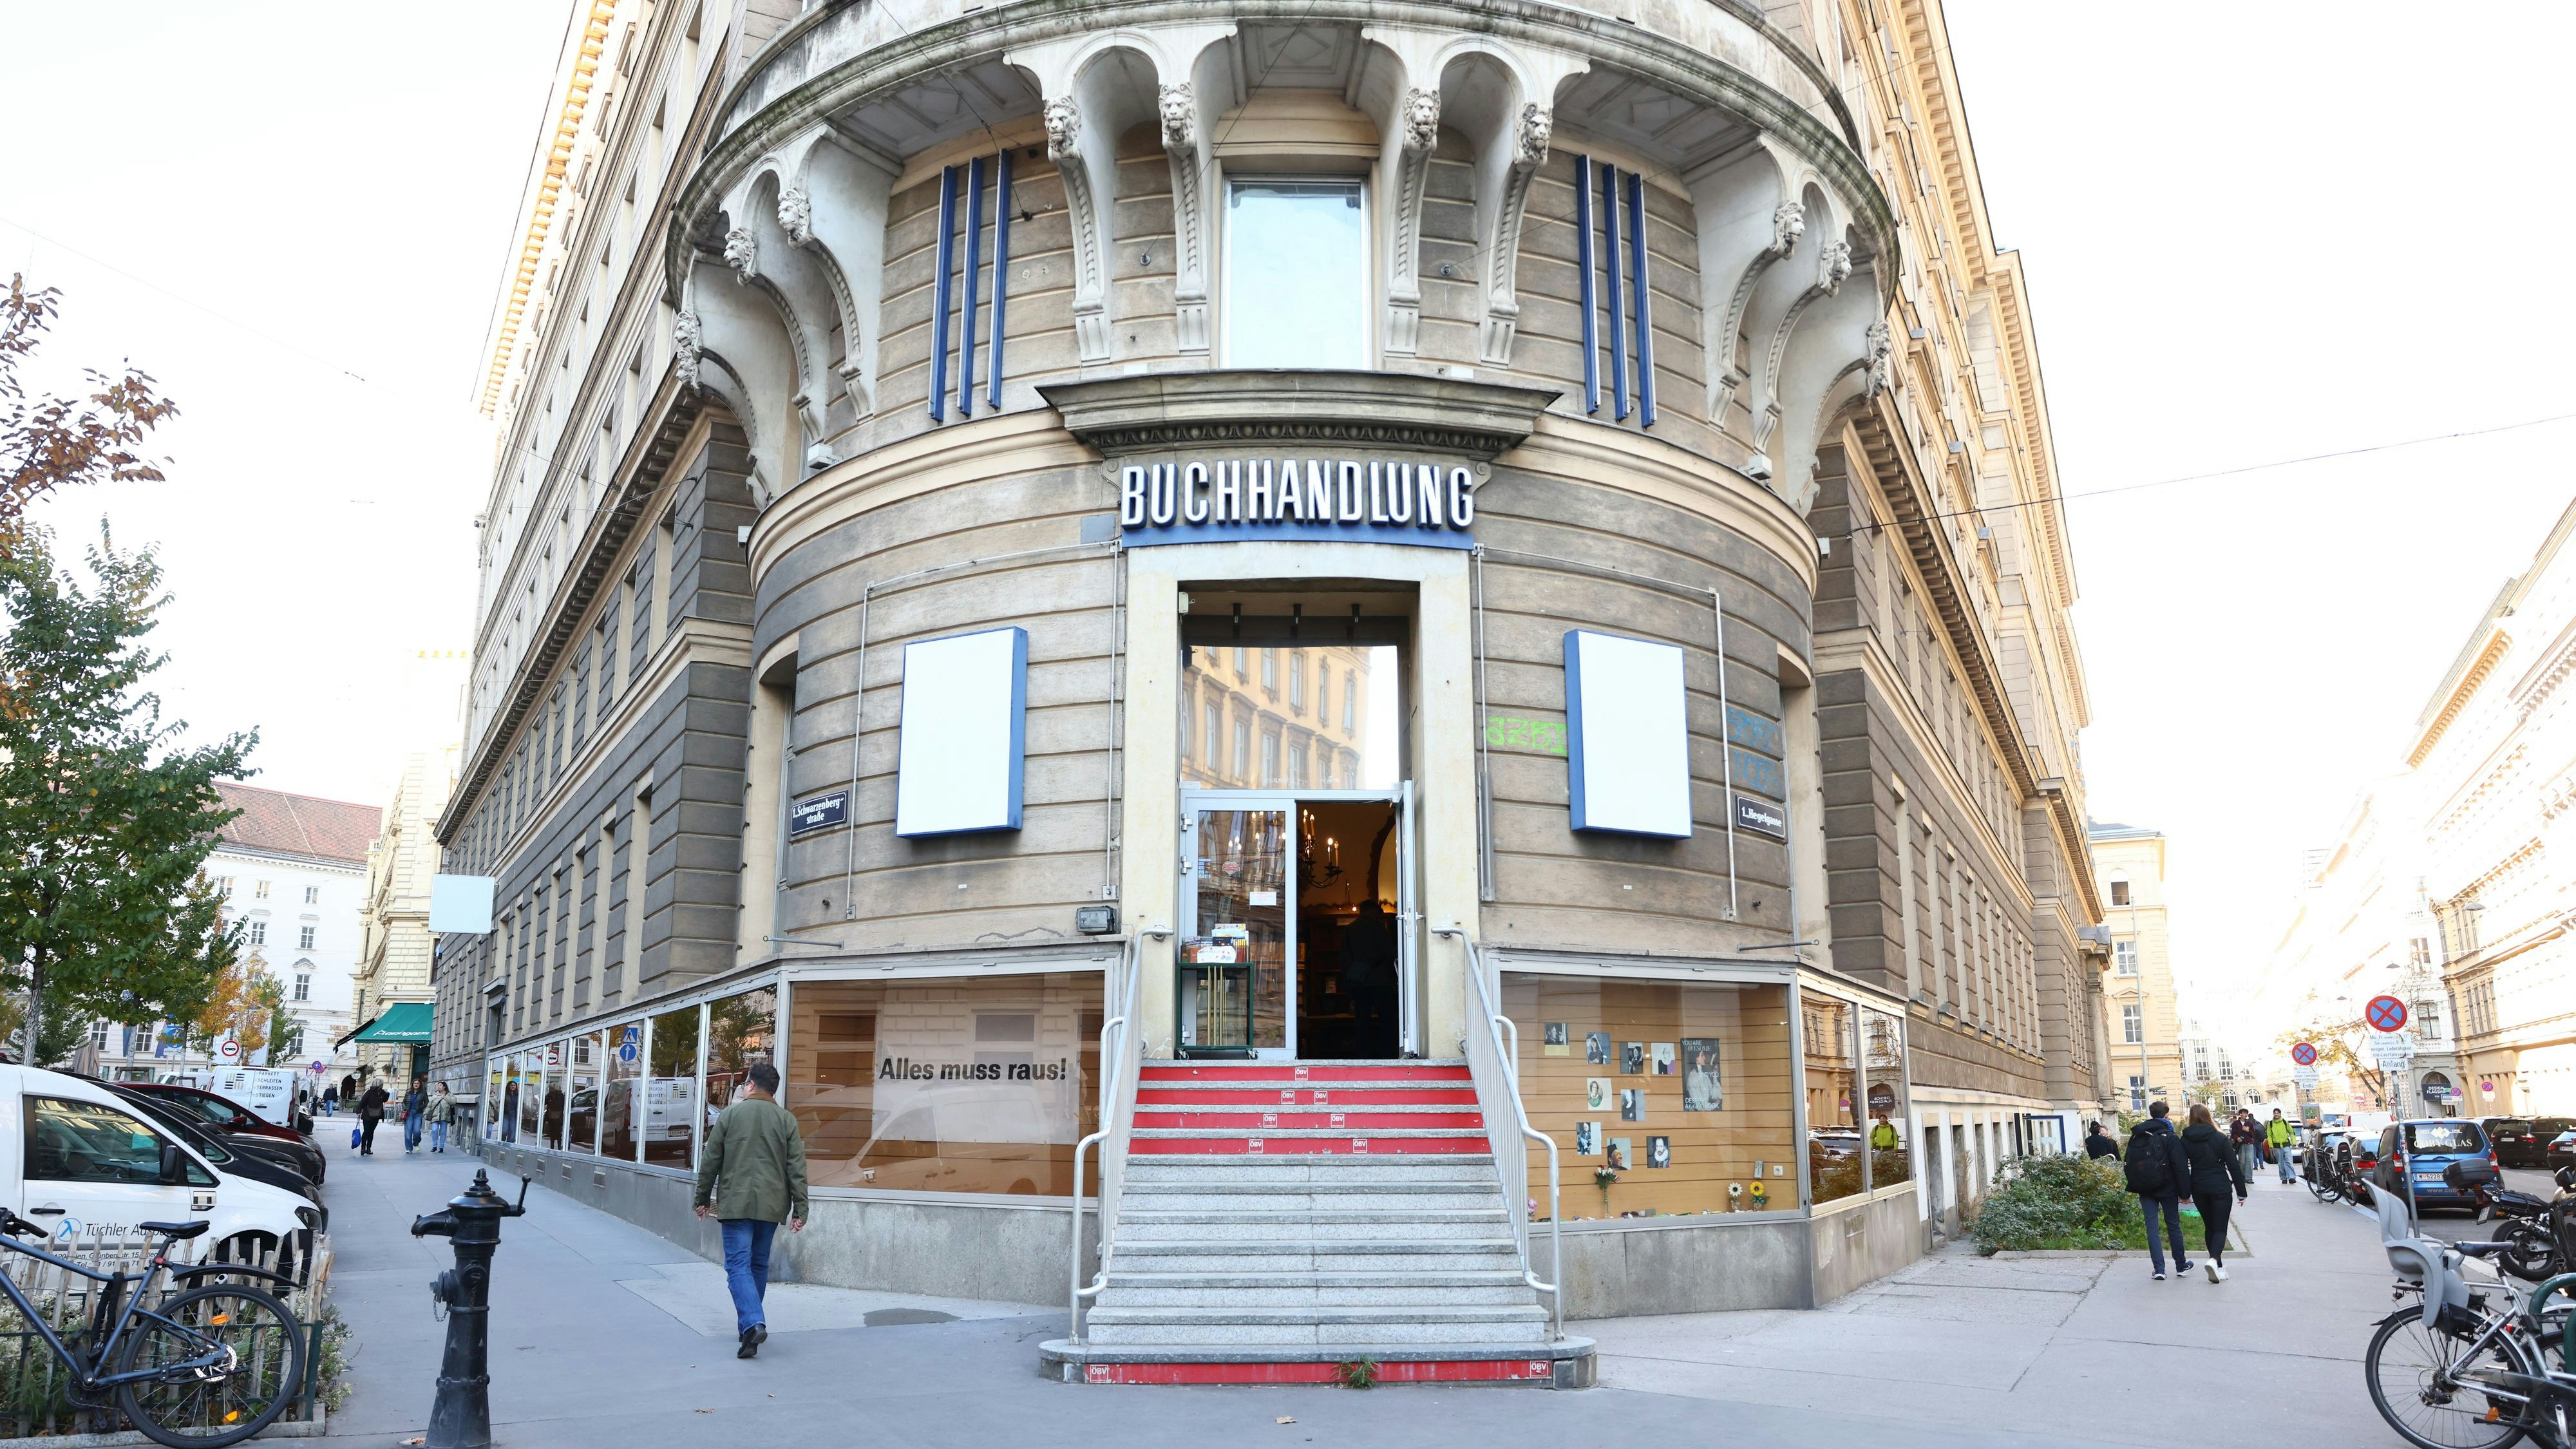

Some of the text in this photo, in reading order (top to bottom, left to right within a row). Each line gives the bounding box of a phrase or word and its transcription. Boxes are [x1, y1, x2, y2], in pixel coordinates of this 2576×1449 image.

[1121, 459, 1474, 531] BUCHHANDLUNG
[806, 811, 824, 824] straße
[879, 1057, 1066, 1080] Alles muss raus!
[2445, 1139, 2472, 1148] GLAS
[86, 1223, 127, 1236] Tüchler
[1092, 1366, 1106, 1375] ÖBV
[1531, 1361, 1546, 1370] ÖBV
